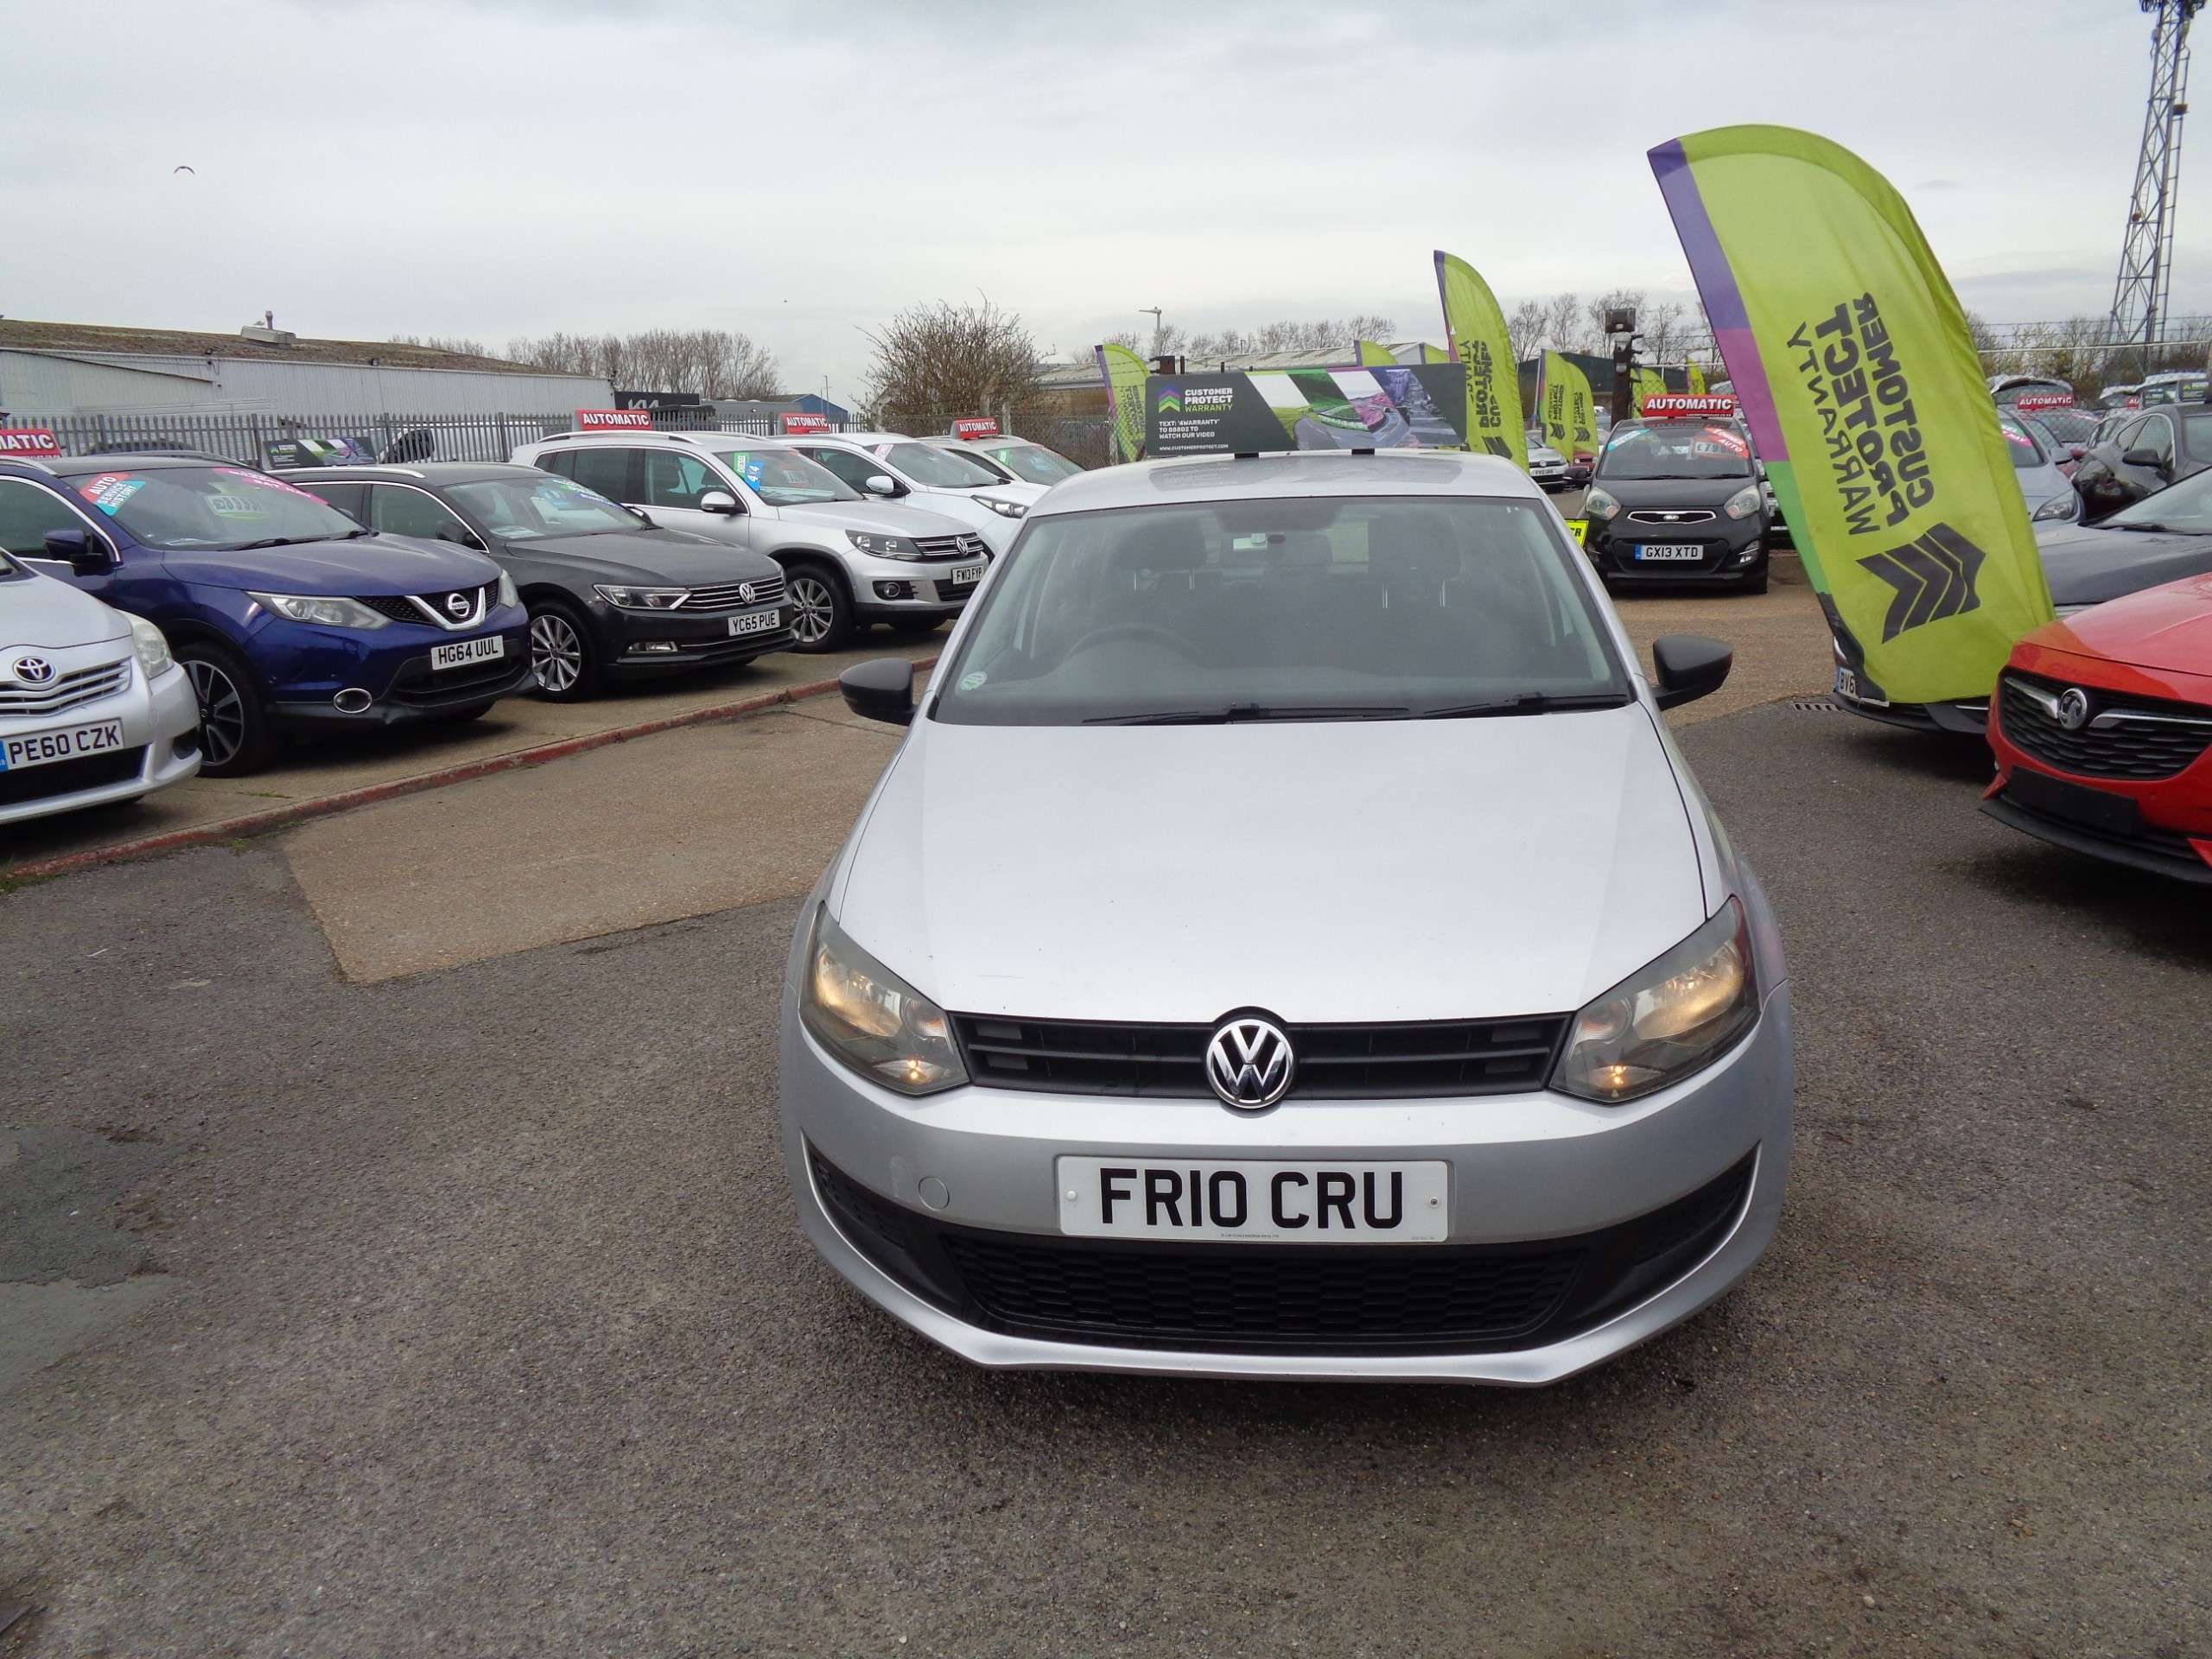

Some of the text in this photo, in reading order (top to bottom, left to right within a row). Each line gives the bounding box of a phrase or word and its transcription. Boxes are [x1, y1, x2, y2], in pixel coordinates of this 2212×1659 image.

[1185, 388, 1233, 397] CUSTOMER
[1185, 395, 1233, 404] PROTECT
[1646, 397, 1732, 410] AUTOMATIC
[2019, 397, 2072, 405] AUTOMATIC
[1185, 404, 1233, 412] WARRANTY
[582, 413, 649, 426] AUTOMATIC
[786, 416, 829, 428] AUTOMATIC
[959, 421, 996, 432] AUTOMATIC
[88, 476, 118, 495] AUTO
[1646, 547, 1698, 557] GX13 XTD
[733, 613, 776, 632] YC65 PUE
[438, 639, 499, 664] HG64 UUL
[8, 725, 119, 764] PE60 CZK
[1099, 1167, 1403, 1230] FR10 CRU
